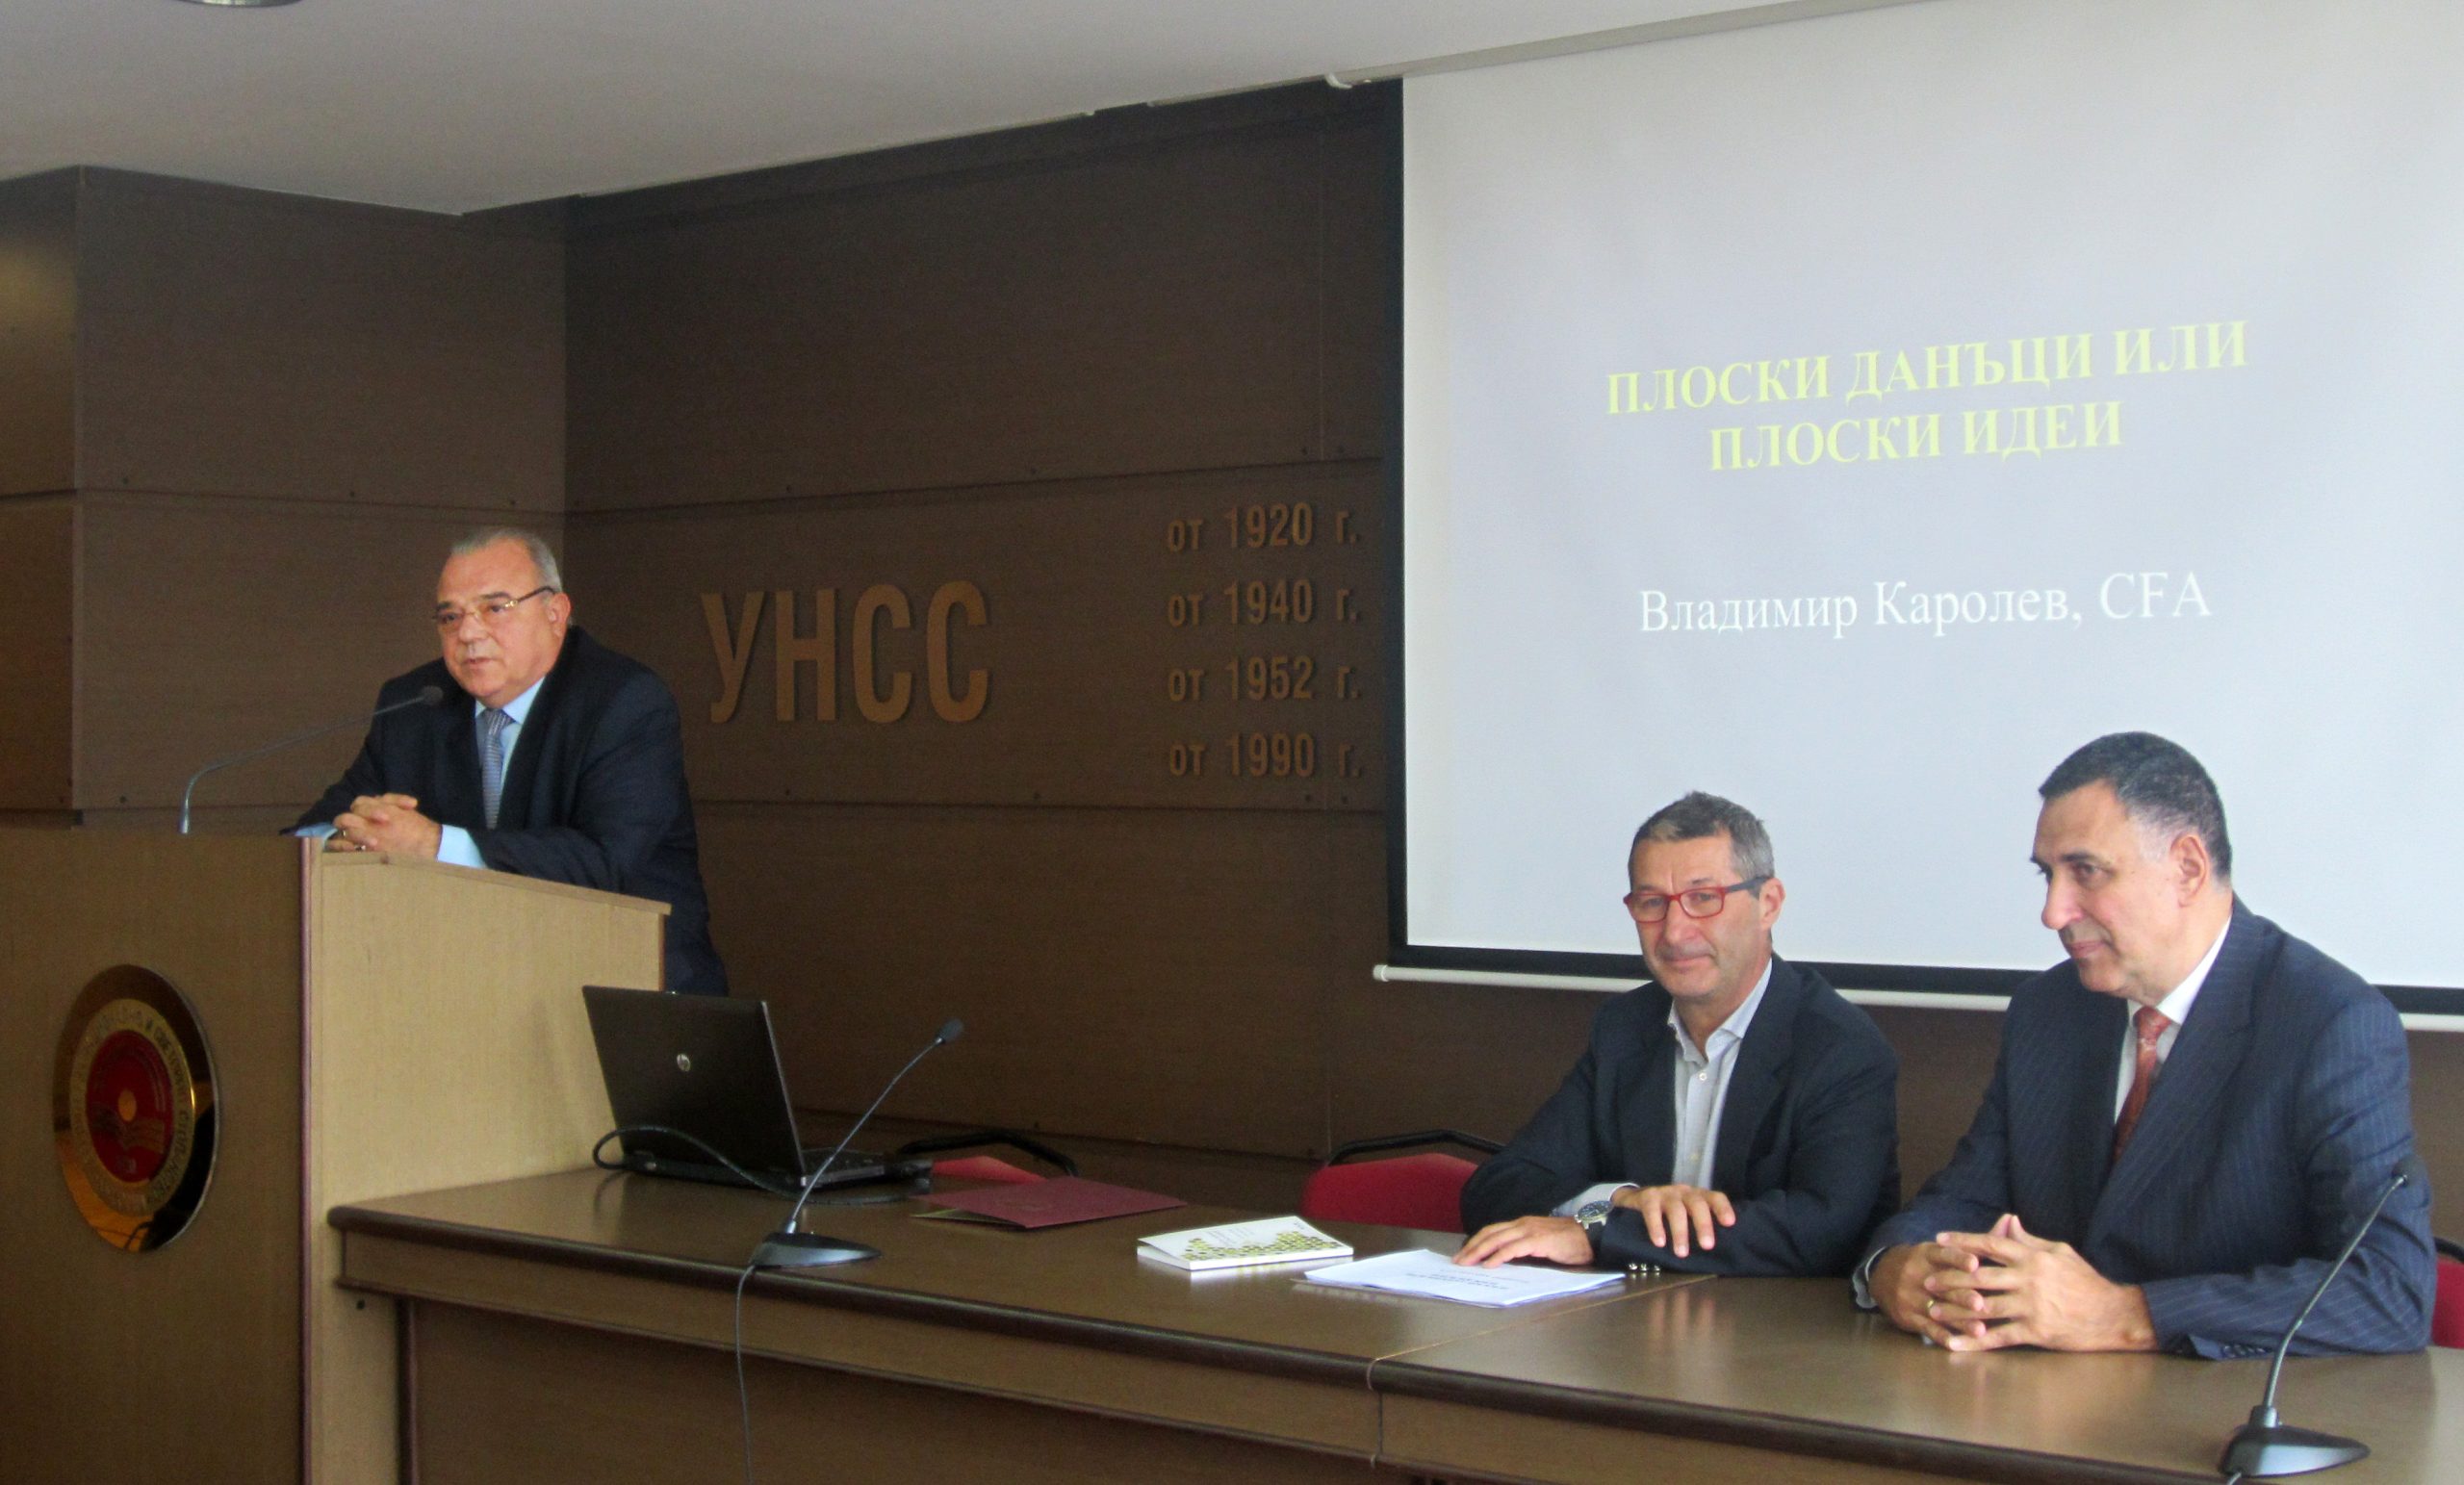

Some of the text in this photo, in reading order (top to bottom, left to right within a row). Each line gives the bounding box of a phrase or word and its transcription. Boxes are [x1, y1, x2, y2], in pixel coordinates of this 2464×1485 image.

[1606, 320, 2249, 415] ПЛОСКИ ДАНЪЦИ ИЛИ
[1709, 399, 2124, 472] ПЛОСКИ ИДЕИ
[1168, 518, 1204, 552] от
[1223, 502, 1313, 550] 1920
[1168, 594, 1204, 627] от
[1223, 579, 1313, 626] 1940
[1639, 571, 2213, 639] Владимир Каролев, CFA
[701, 580, 990, 724] УНСС
[1168, 669, 1205, 703] от
[1225, 655, 1314, 702] 1952
[1168, 743, 1206, 778] от
[1226, 732, 1315, 779] 1990
